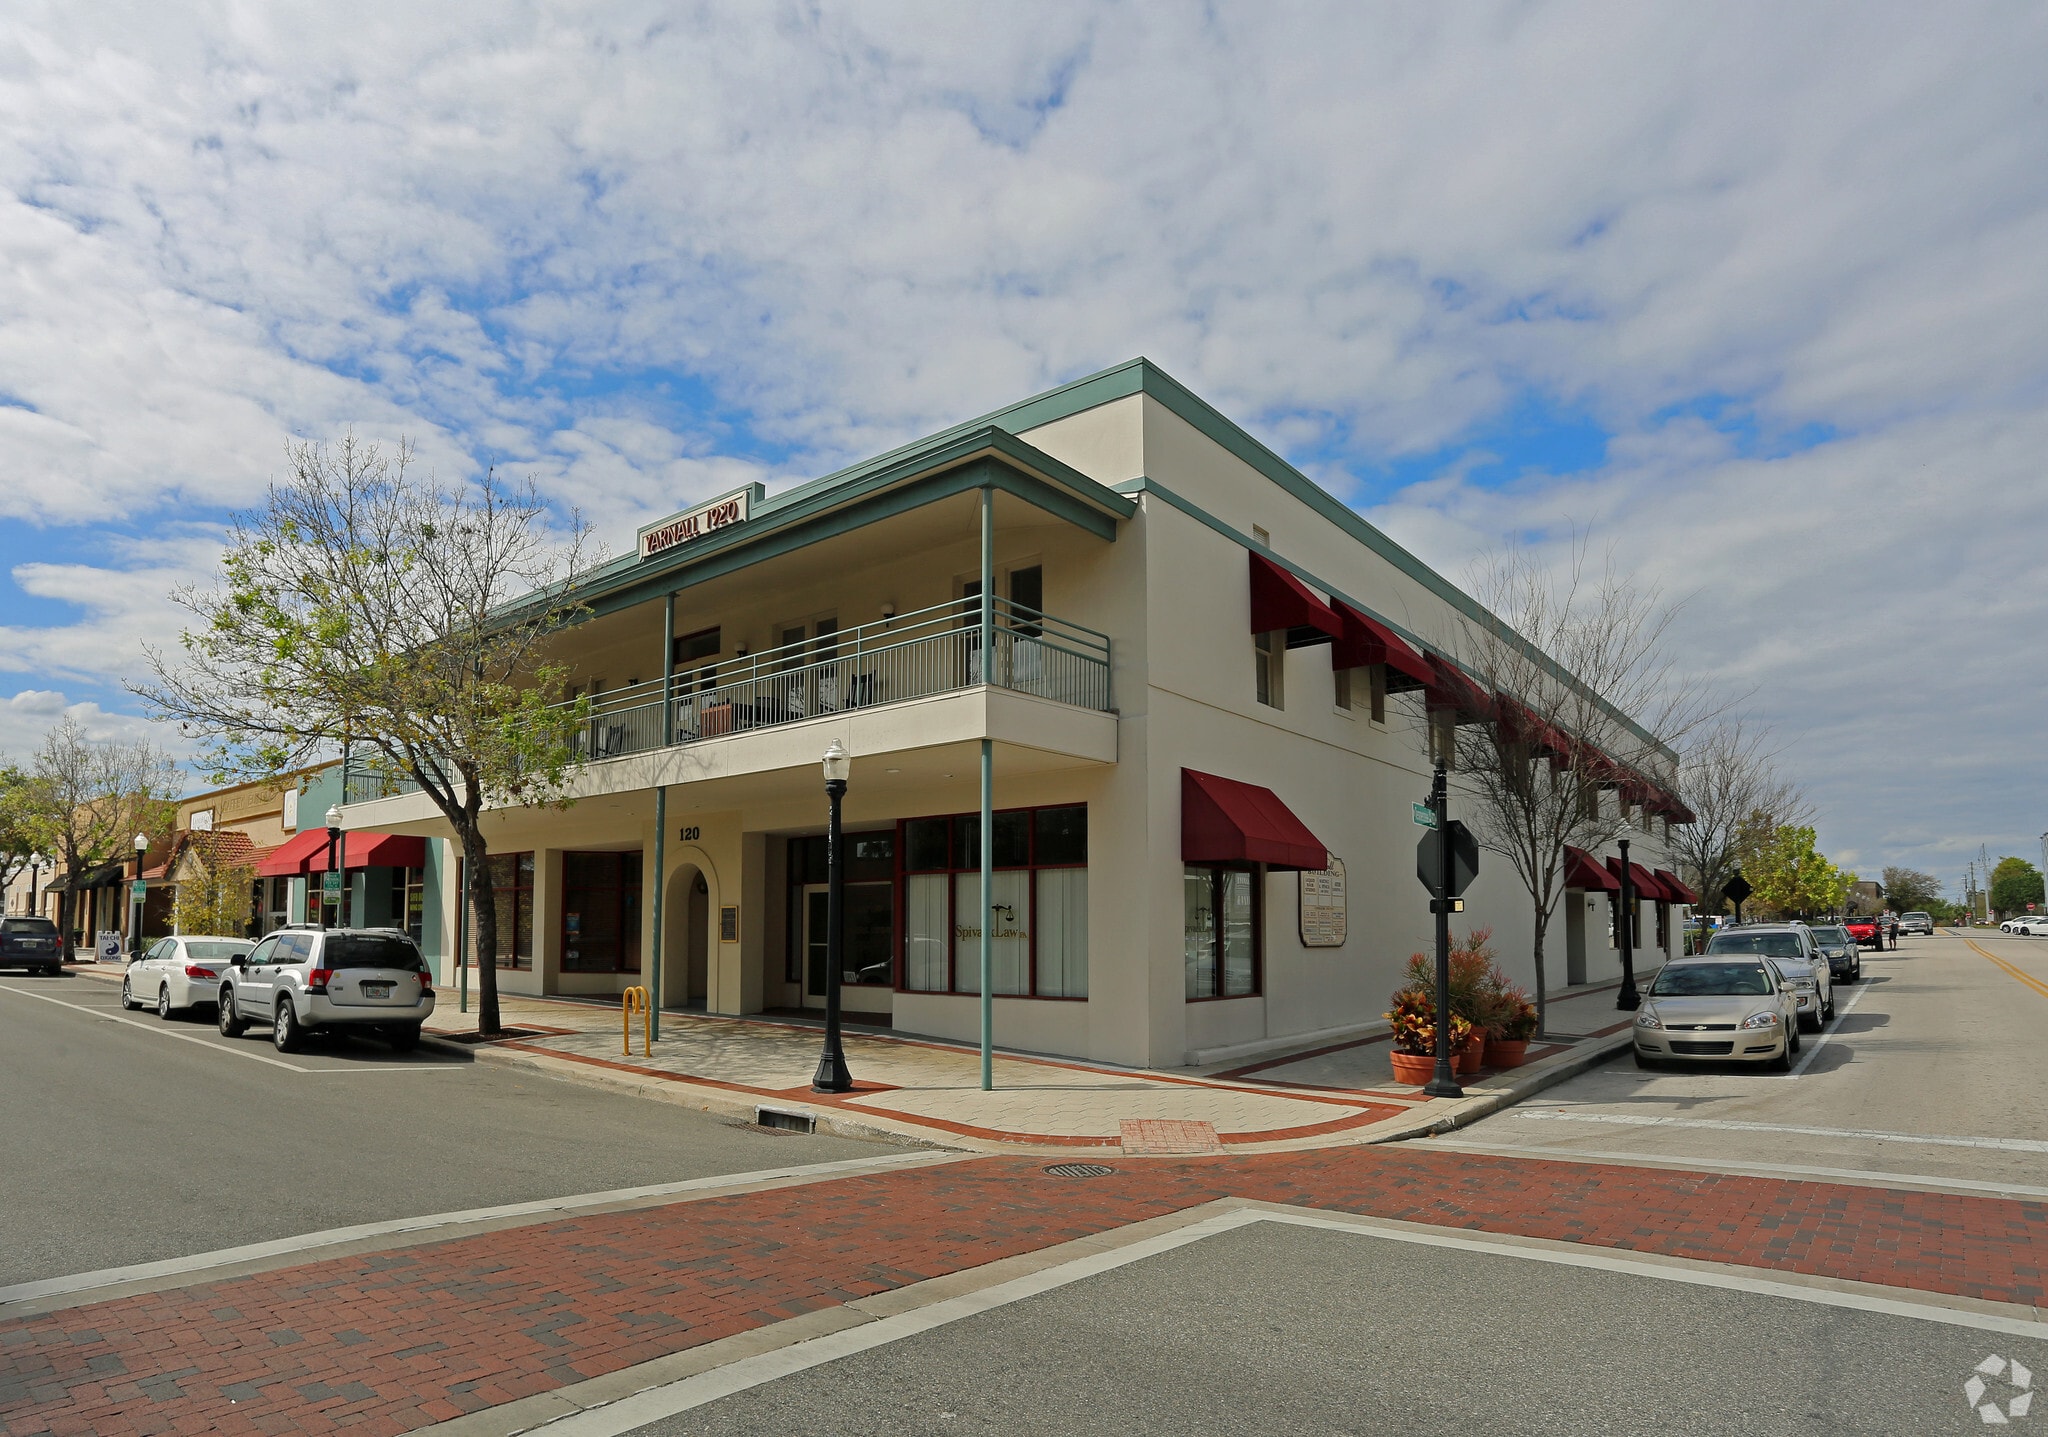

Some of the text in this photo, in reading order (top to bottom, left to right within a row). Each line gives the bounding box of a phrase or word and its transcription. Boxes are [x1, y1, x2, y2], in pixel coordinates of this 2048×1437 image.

[646, 500, 739, 552] YARNALL 1920
[679, 826, 700, 842] 120
